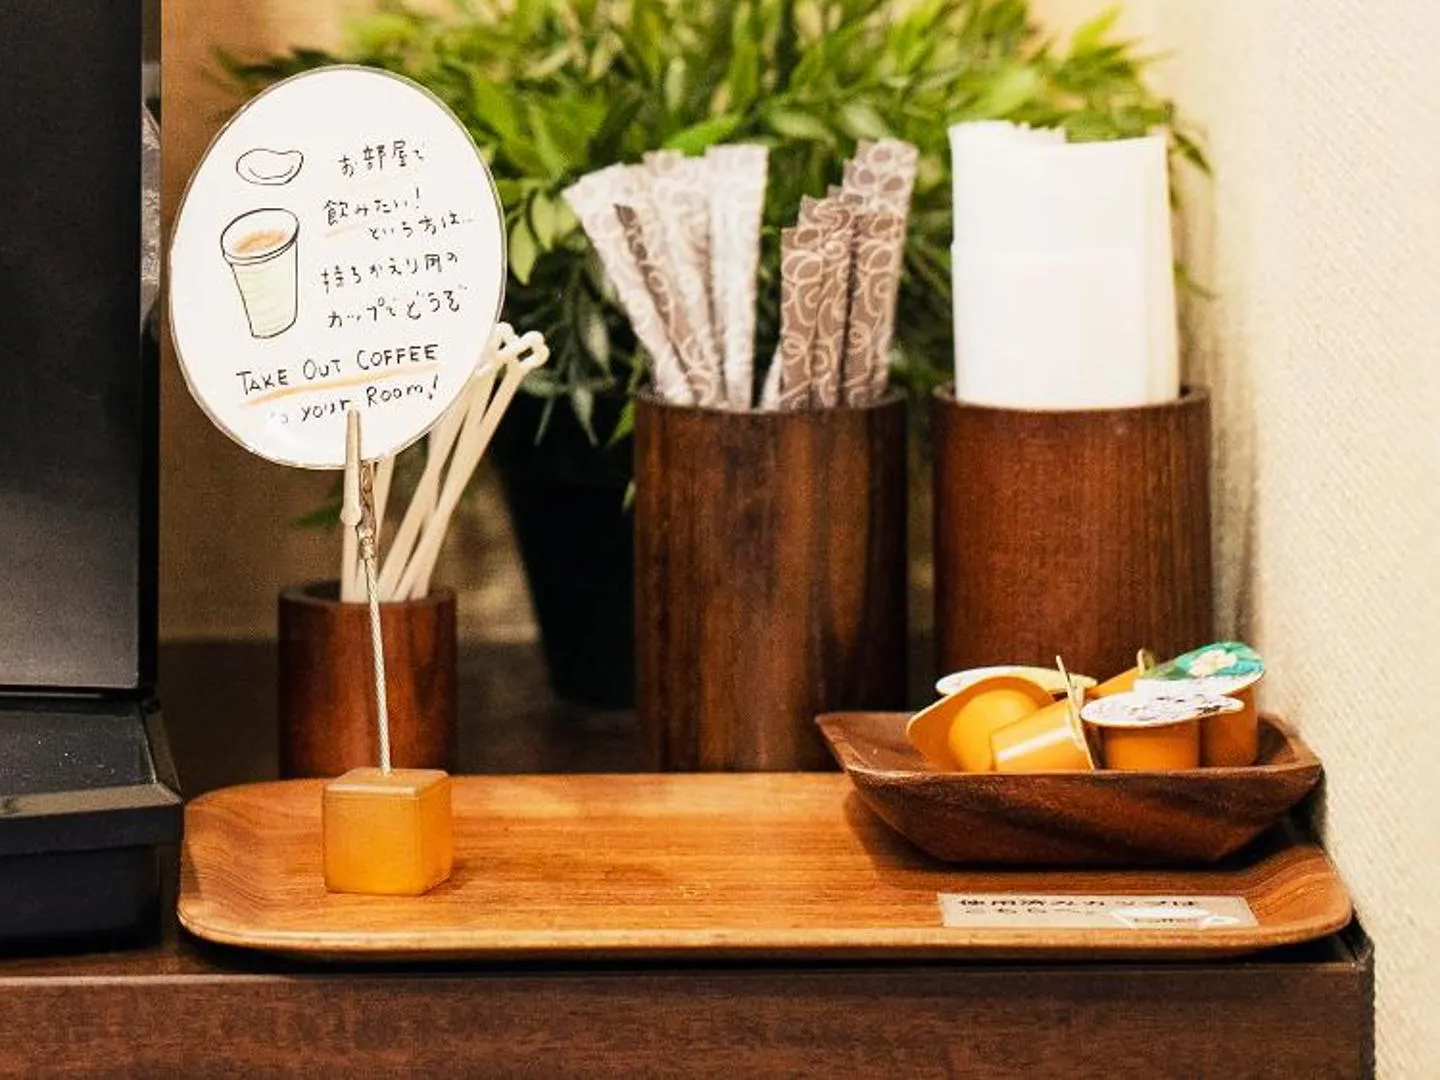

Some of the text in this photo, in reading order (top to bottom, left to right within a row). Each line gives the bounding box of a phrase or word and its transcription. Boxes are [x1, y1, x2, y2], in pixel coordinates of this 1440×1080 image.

[236, 369, 288, 395] TAKE
[357, 343, 438, 370] COFFEE
[301, 398, 351, 422] your
